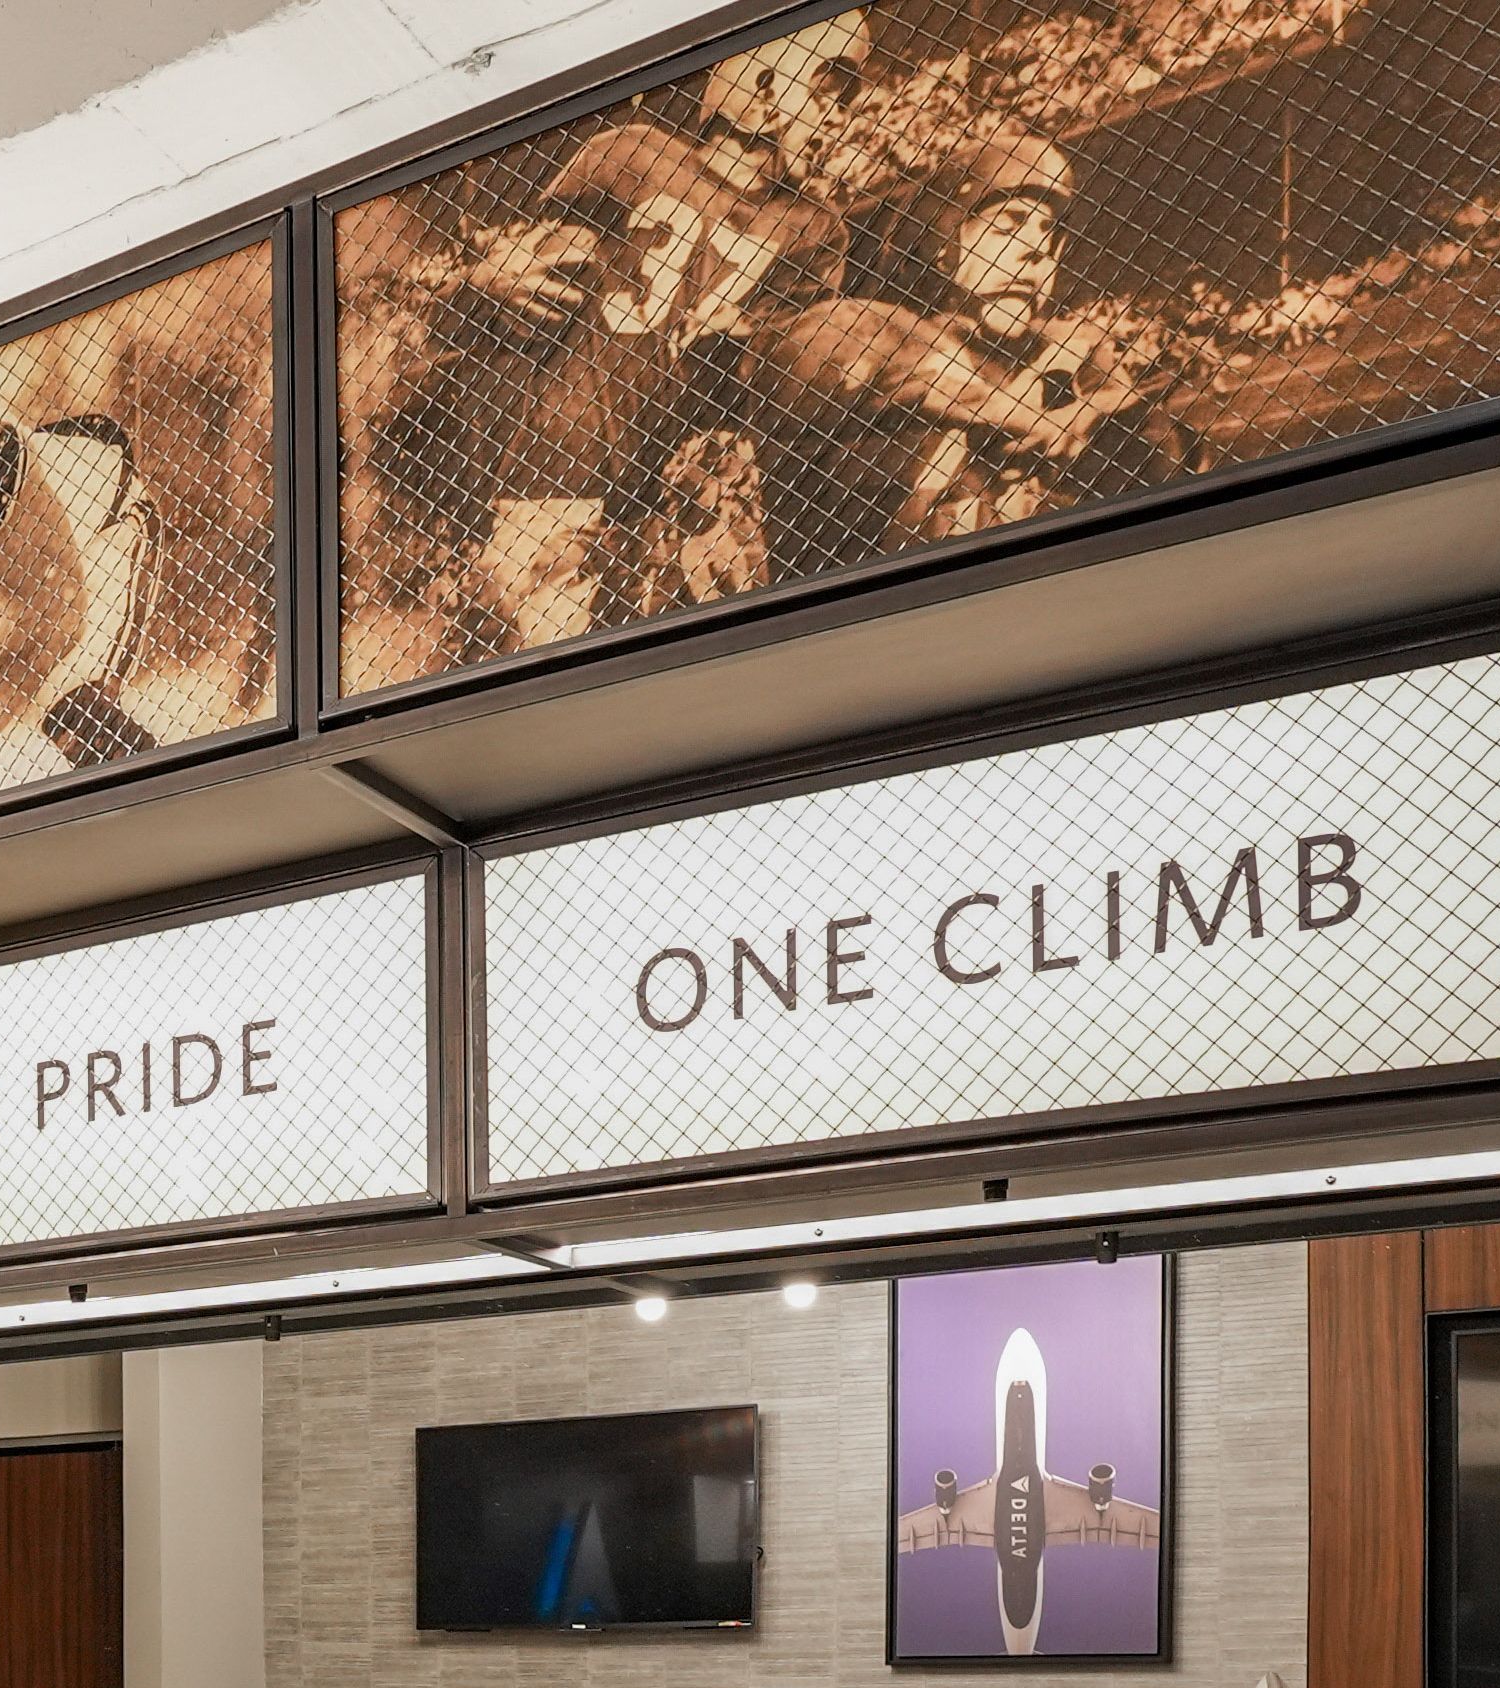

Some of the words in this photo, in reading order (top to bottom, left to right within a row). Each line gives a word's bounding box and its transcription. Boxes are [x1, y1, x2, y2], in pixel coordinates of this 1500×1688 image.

[636, 913, 874, 1033] ONE
[933, 832, 1362, 985] CLIMB
[37, 1018, 278, 1130] PRIDE
